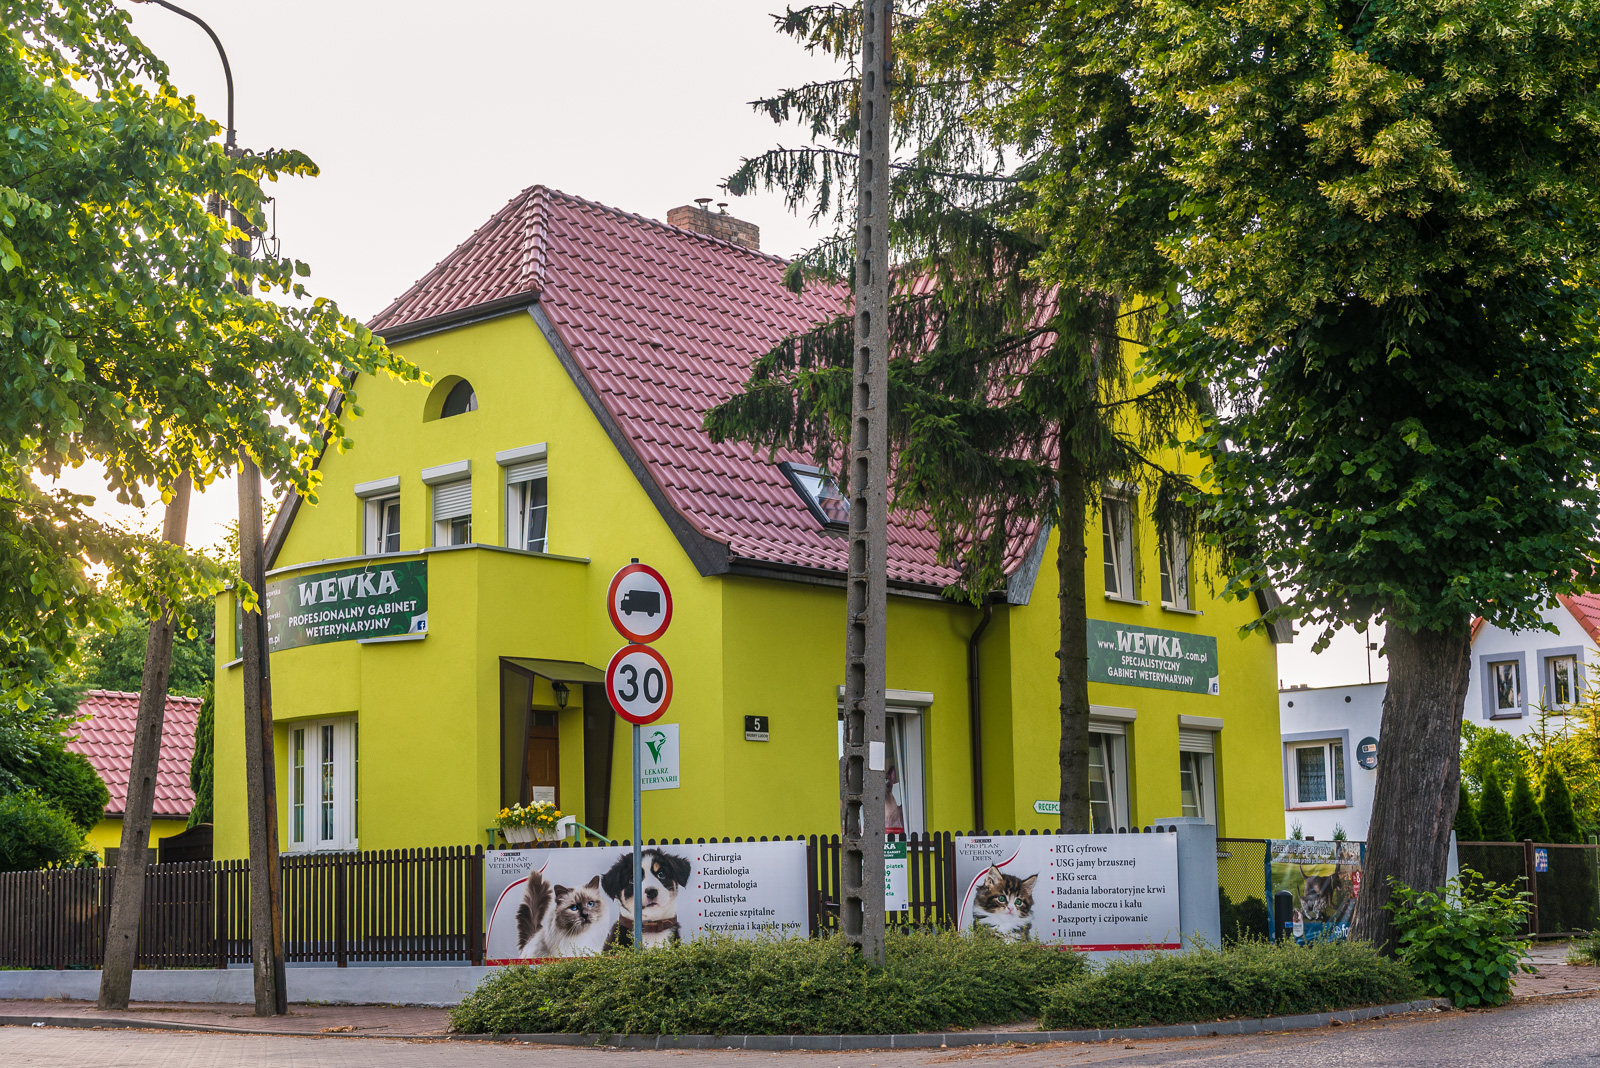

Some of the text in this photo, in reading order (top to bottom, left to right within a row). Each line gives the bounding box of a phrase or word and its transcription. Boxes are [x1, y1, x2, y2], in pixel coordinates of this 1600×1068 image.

[298, 569, 400, 607] WETKA
[288, 606, 365, 627] PROFESJONALNY
[367, 600, 417, 615] GABINET
[305, 617, 391, 638] WETERYNARYJNY
[1121, 655, 1180, 671] SPECJALISTYCZNY
[1107, 666, 1194, 685] GABINET WETERYNARYJNY
[618, 664, 664, 704] 30
[754, 717, 760, 731] 5
[644, 767, 669, 776] LEKARZ
[641, 775, 678, 785] ETERYNARII
[1055, 844, 1108, 855] RTG cyfrowe
[702, 852, 742, 863] Chirurgia
[1056, 858, 1136, 869] USG jamy brzusznej
[703, 867, 750, 877] Kardiologia
[1056, 873, 1075, 881] EKG
[703, 880, 758, 891] Dermatologia
[1057, 885, 1166, 896] Badania laboratoryjne krwi
[703, 894, 747, 905] Okulistyka
[1057, 900, 1089, 909] Badanie
[1091, 901, 1118, 909] moczu
[1124, 899, 1142, 908] kału
[704, 907, 775, 918] Leczenie szpitalne
[1057, 914, 1097, 925] Paszporty
[1103, 914, 1149, 925] czipowanie
[704, 922, 745, 933] Strzyżenia
[781, 921, 801, 931] psów
[1068, 928, 1087, 937] inne
